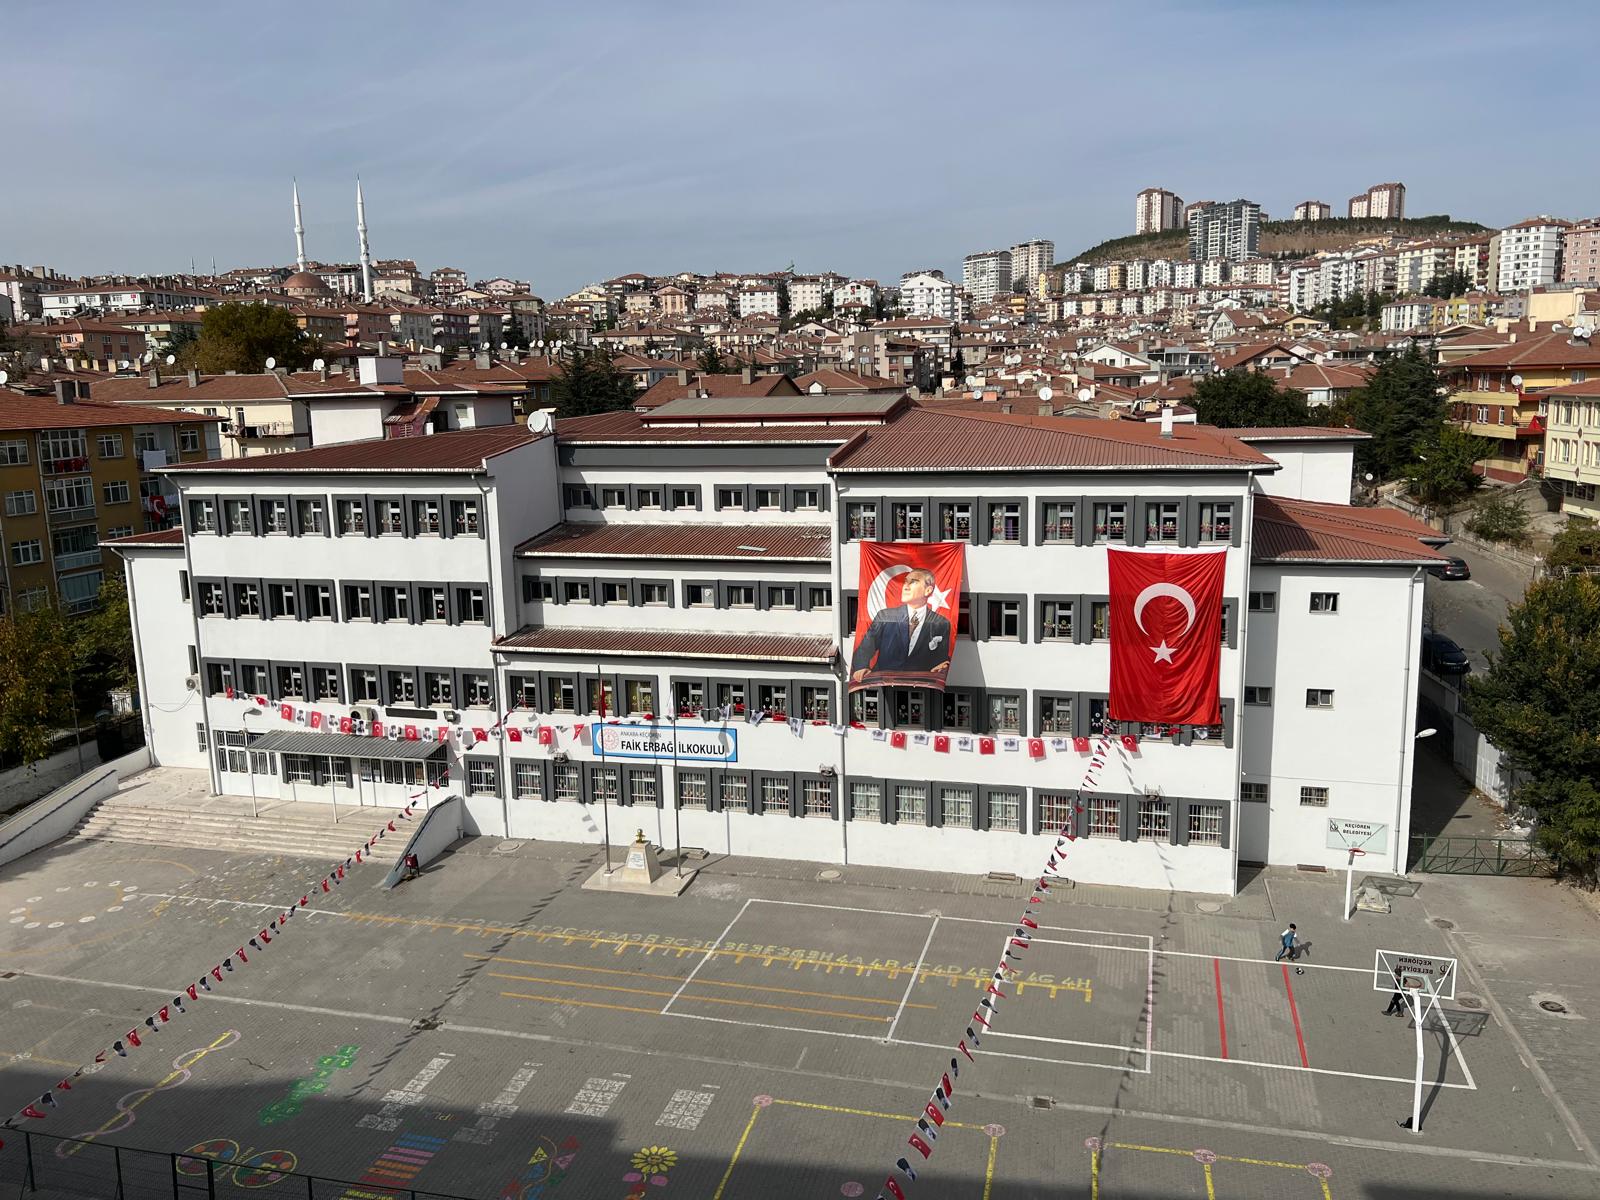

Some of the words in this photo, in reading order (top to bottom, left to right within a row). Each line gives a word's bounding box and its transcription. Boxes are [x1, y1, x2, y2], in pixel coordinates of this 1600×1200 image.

[621, 740, 641, 751] FAİK
[678, 742, 725, 755] İLKOKULU
[662, 936, 689, 946] 3C
[1026, 971, 1056, 983] 4G
[1061, 976, 1092, 989] 4H
